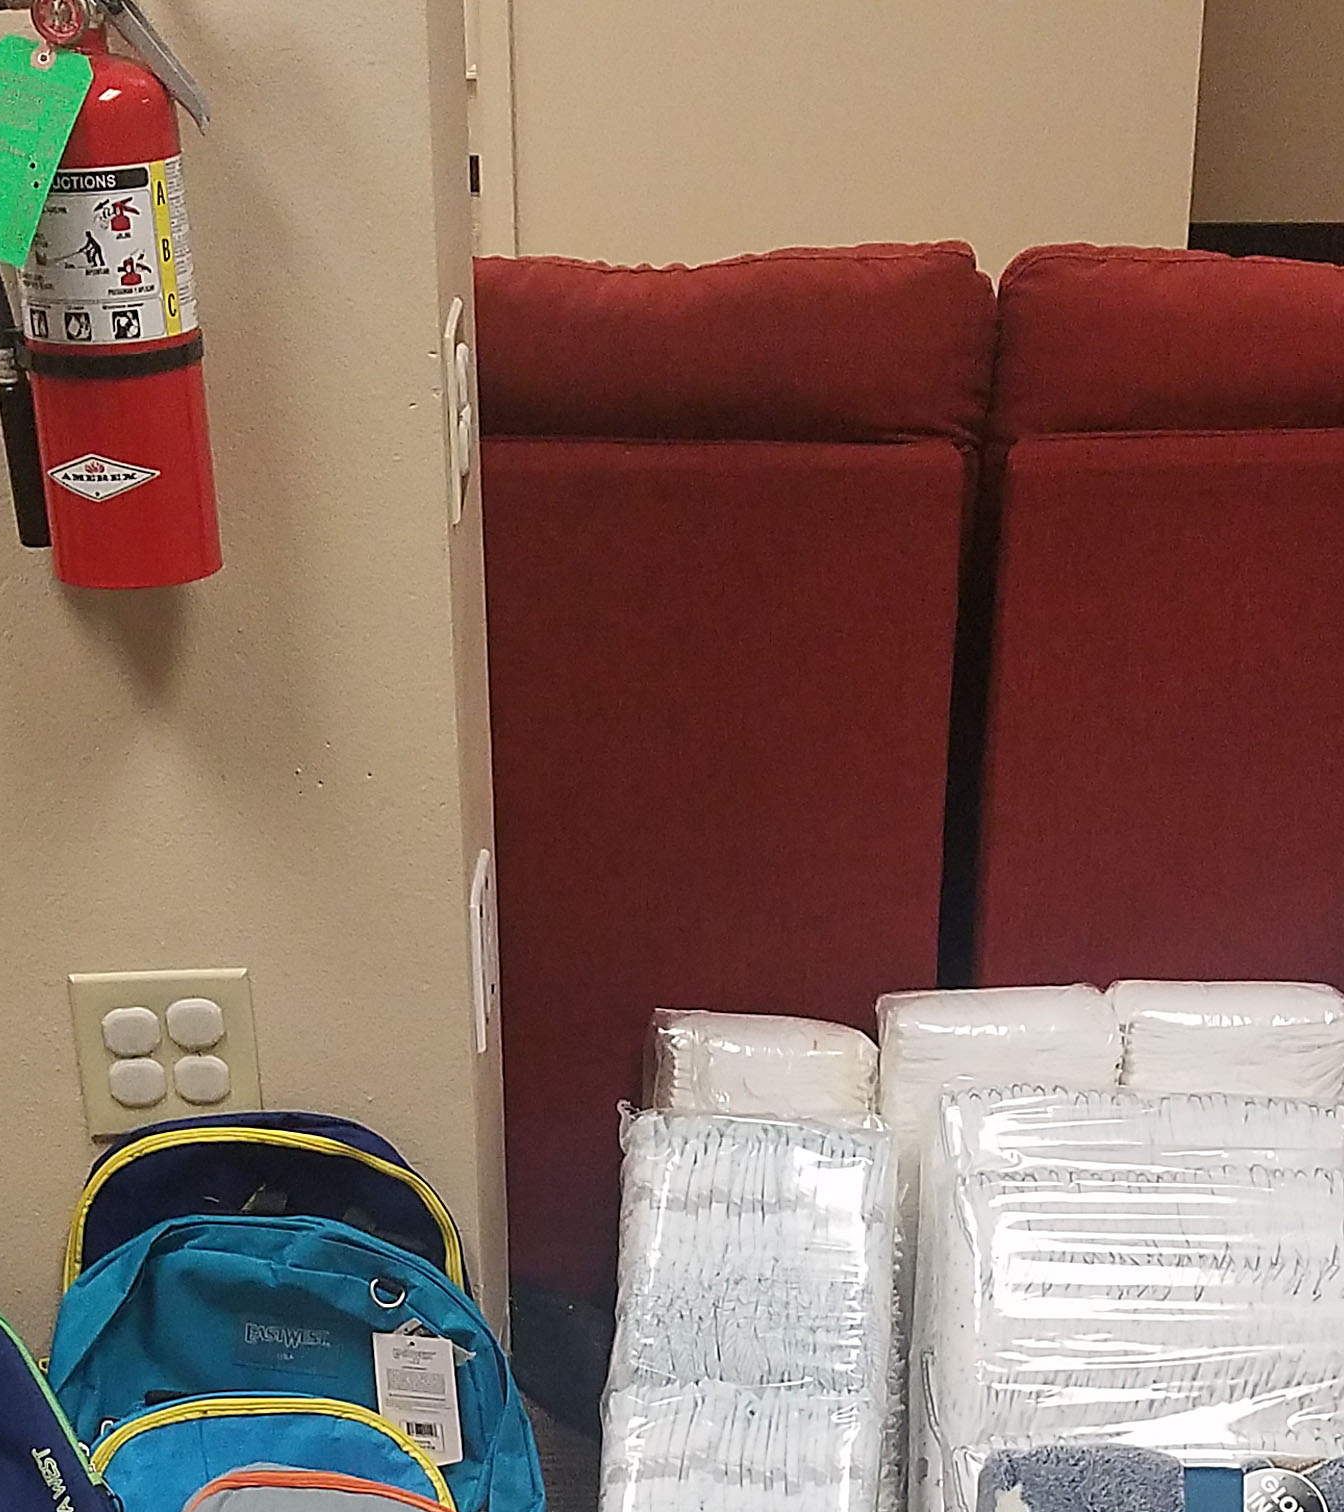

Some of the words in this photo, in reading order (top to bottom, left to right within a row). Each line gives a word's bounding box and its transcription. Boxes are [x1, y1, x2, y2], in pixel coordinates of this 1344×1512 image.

[156, 180, 166, 206] A
[162, 238, 171, 262] B
[167, 293, 177, 317] C
[31, 1447, 67, 1500] WEST
